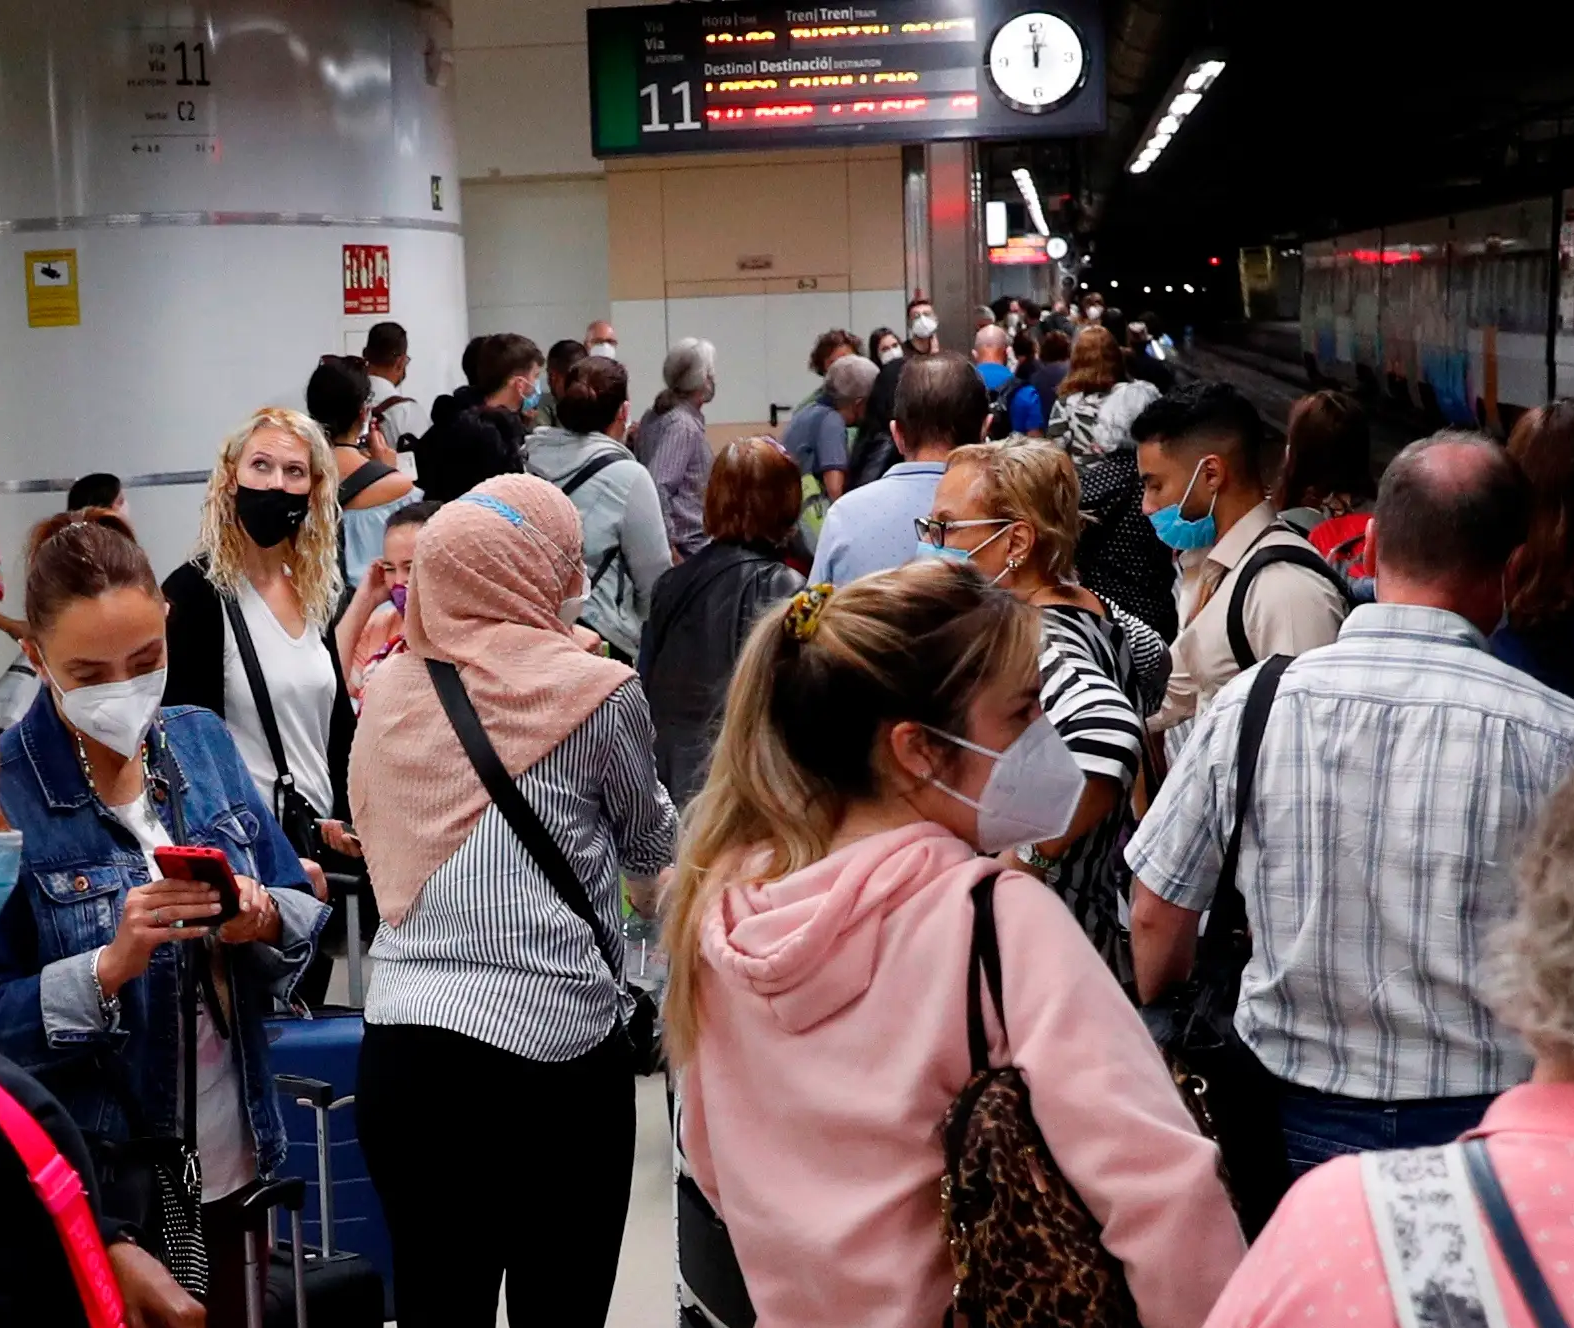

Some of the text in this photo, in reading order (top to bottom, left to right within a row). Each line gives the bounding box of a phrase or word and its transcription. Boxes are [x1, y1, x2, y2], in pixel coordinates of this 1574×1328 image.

[785, 10, 814, 22] Tren
[818, 8, 850, 21] Tren
[173, 41, 211, 86] 11
[704, 62, 753, 76] Destino
[759, 56, 828, 73] Destinació
[177, 101, 195, 121] C2
[639, 80, 702, 132] 11
